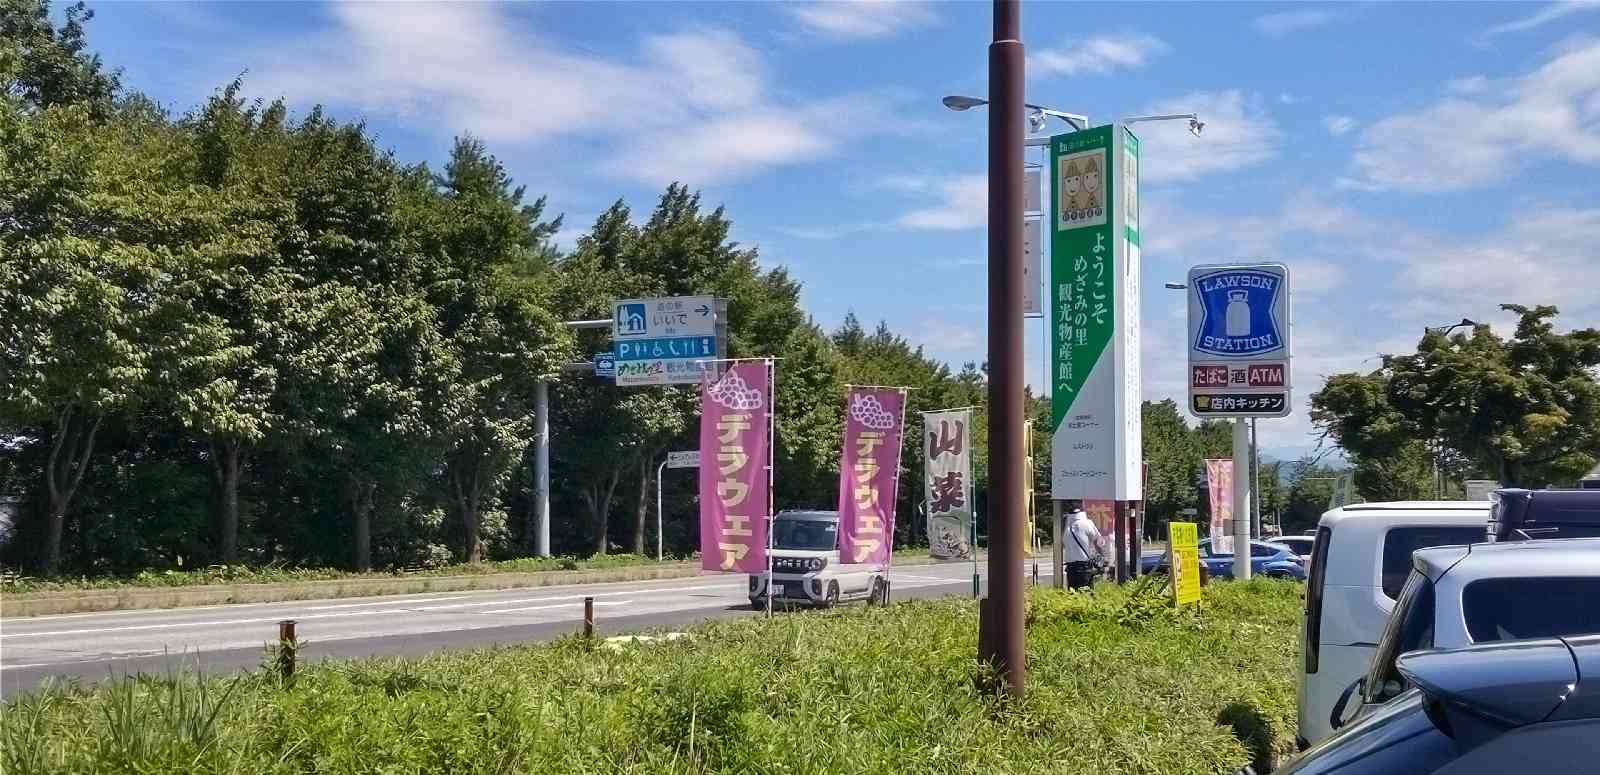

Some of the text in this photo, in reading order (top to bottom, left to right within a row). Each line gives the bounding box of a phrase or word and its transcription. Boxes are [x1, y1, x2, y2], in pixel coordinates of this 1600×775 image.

[1091, 232, 1108, 324] ようこそ
[1202, 275, 1273, 292] LAWSON
[1073, 255, 1088, 346] めざみの里
[652, 313, 688, 327] いいで
[1058, 283, 1073, 393] 観光物産館へ
[1203, 333, 1274, 350] STATION
[1194, 368, 1283, 384] たばこ 酒 ATM
[1211, 397, 1283, 409] 店内キッチン
[929, 420, 965, 513] 山菜
